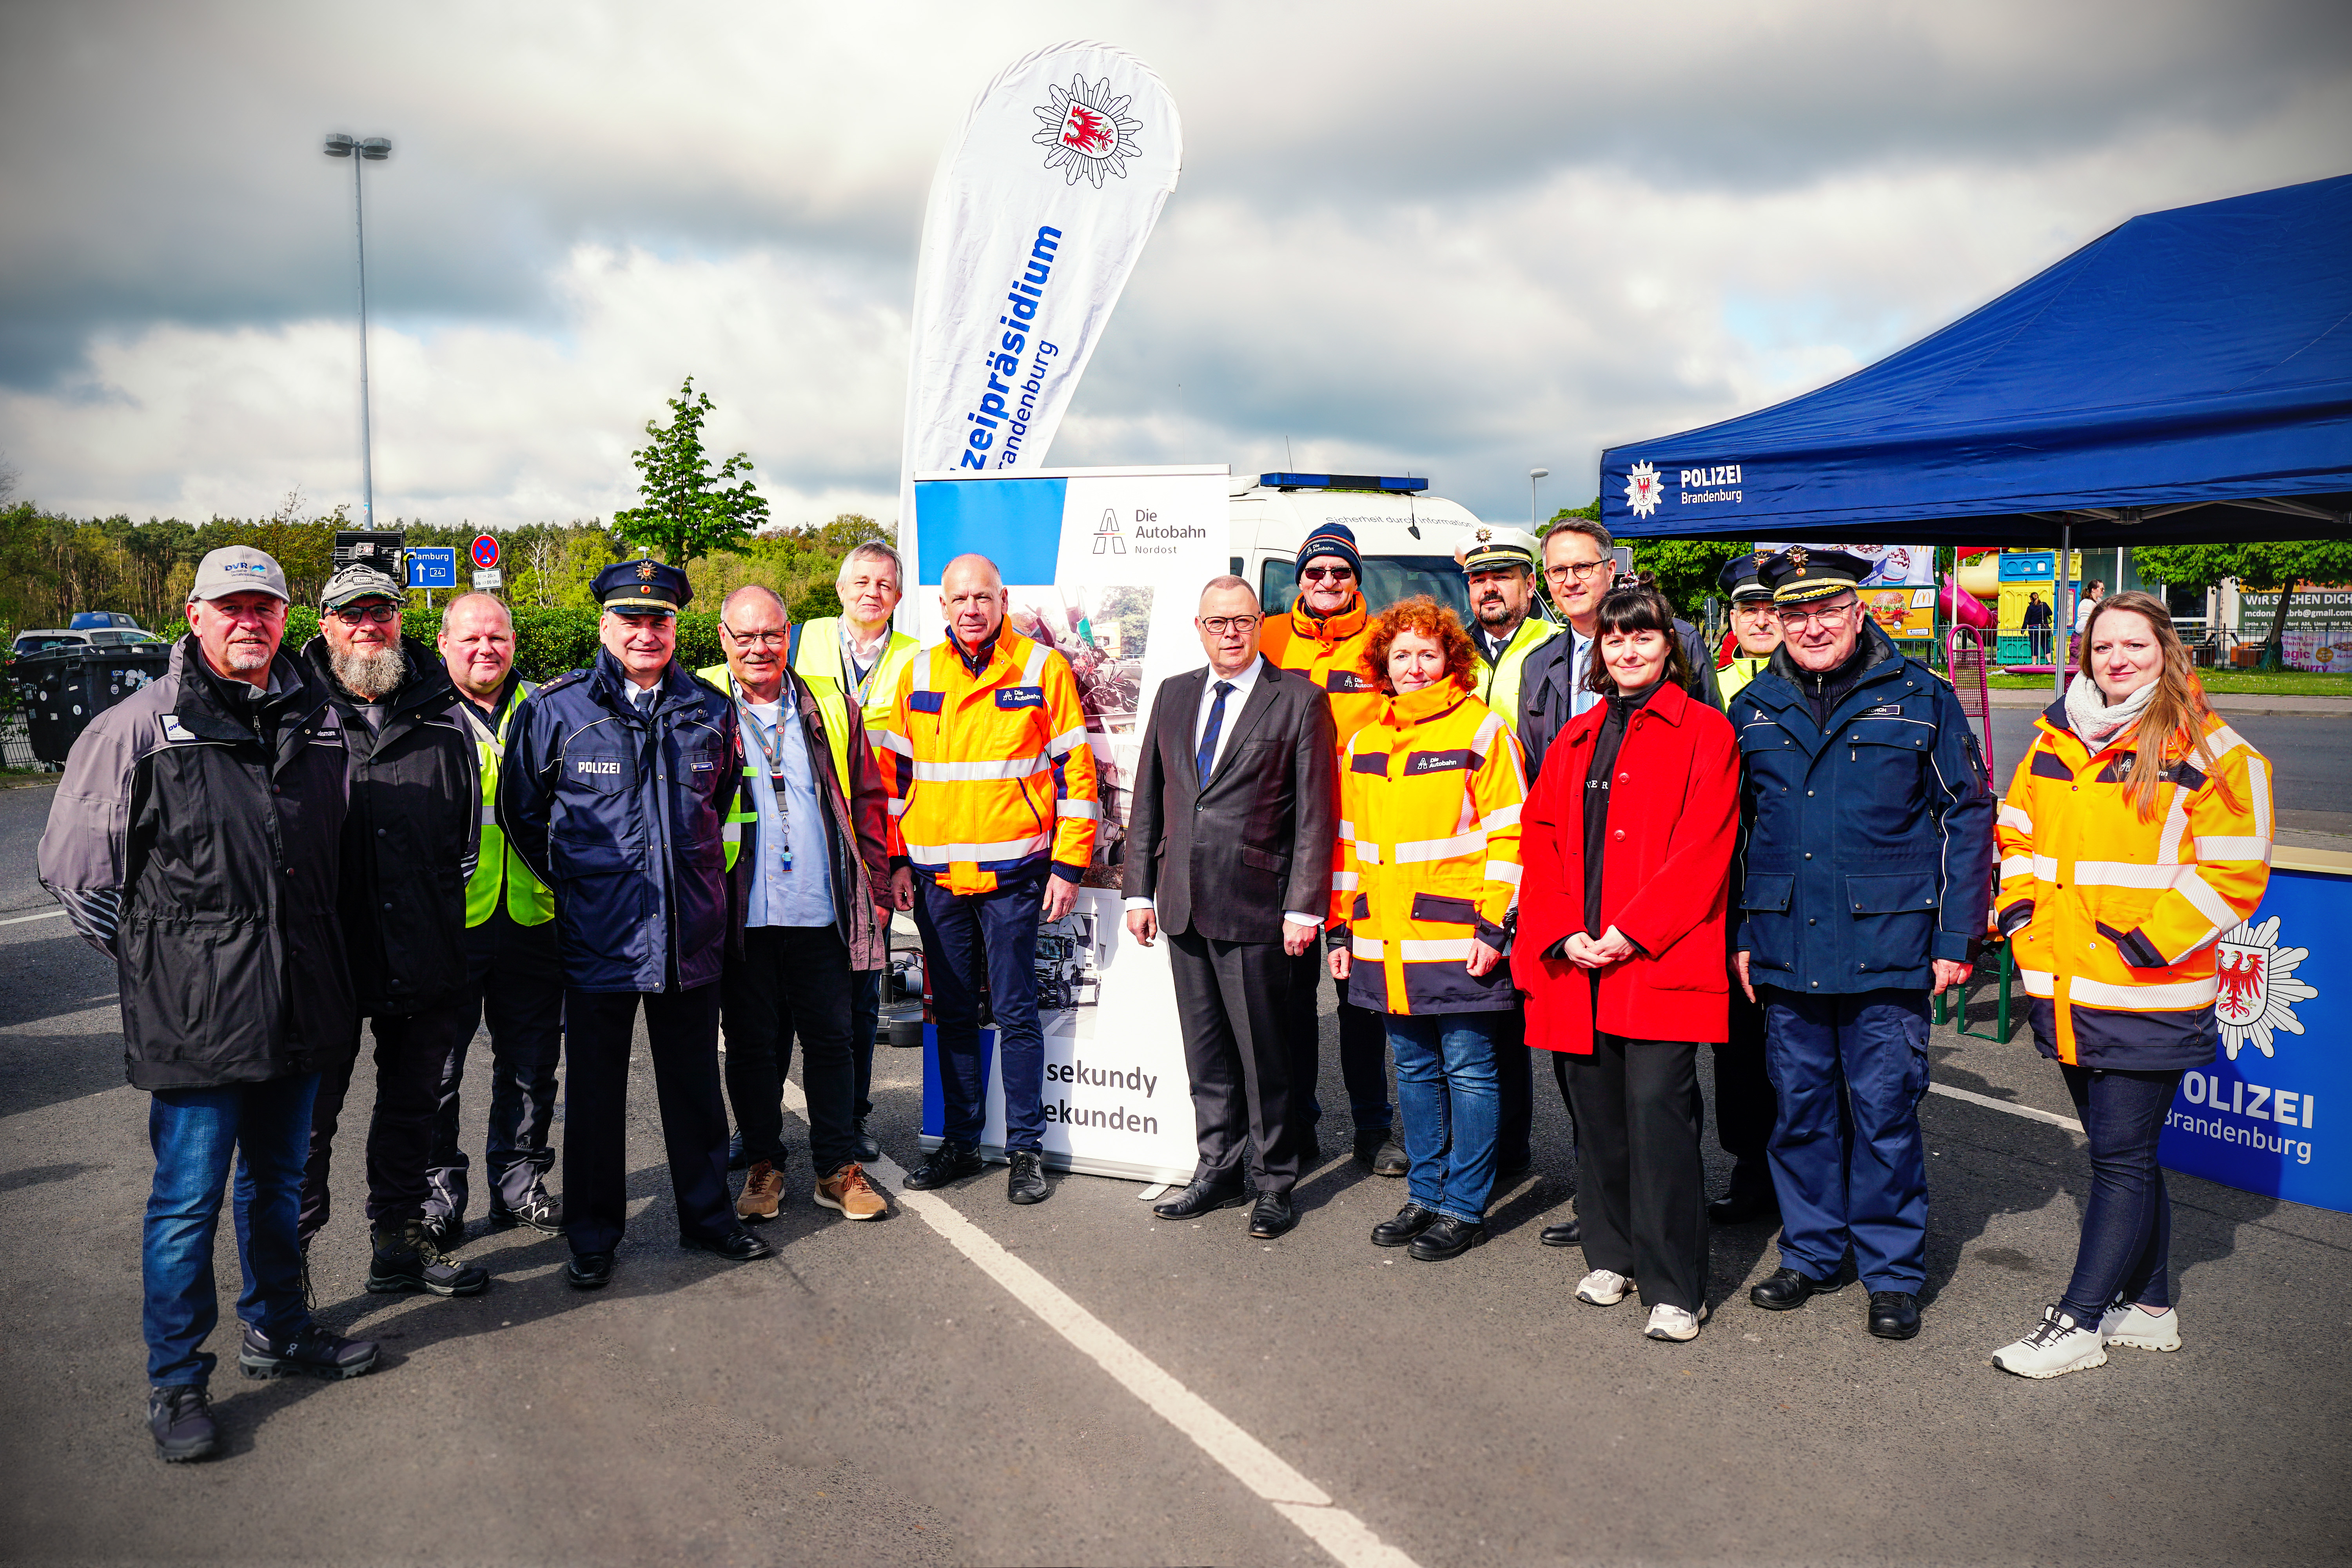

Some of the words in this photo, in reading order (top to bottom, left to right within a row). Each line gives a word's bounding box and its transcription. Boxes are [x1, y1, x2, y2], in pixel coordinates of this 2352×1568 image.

[950, 226, 1062, 470] zeipräsidium
[1681, 465, 1742, 488] POLIZEI
[1681, 489, 1742, 504] Brandenburg
[1136, 509, 1157, 522] Die
[1418, 517, 1474, 528] Information
[1136, 525, 1205, 538] Autobahn
[225, 562, 248, 571] DVR
[2245, 595, 2269, 605] WIR
[578, 762, 620, 774] POLIZEI
[1429, 759, 1457, 768] Autobahn
[1047, 1060, 1157, 1098] sekundy
[2180, 1071, 2314, 1129] OLIZEI
[1044, 1099, 1157, 1134] ekunden
